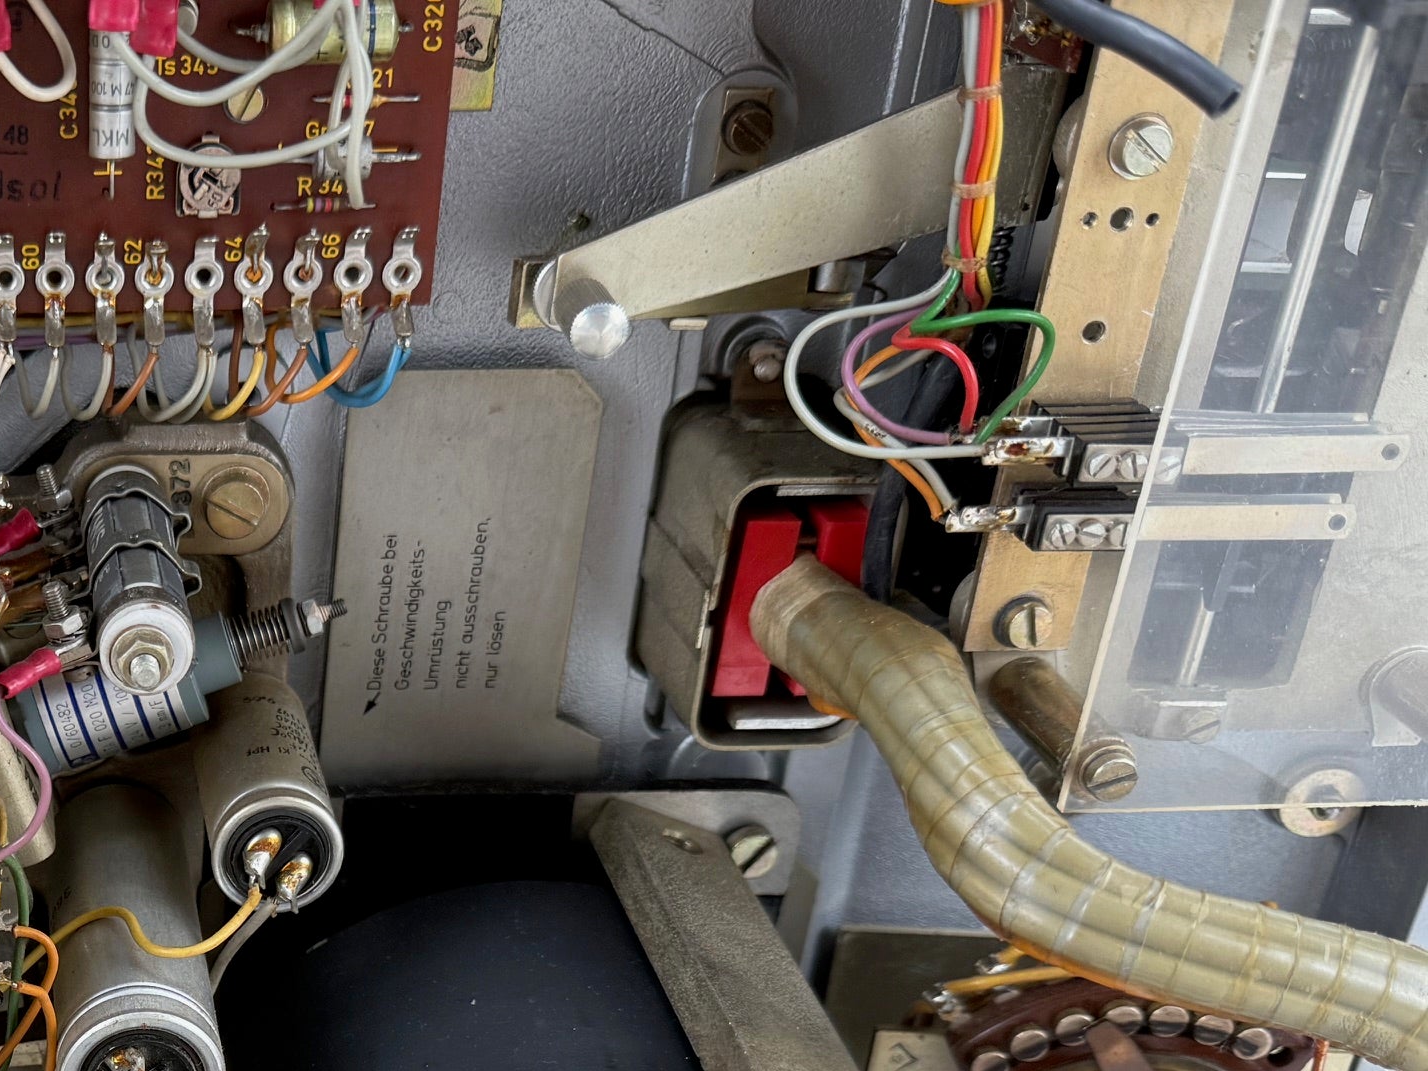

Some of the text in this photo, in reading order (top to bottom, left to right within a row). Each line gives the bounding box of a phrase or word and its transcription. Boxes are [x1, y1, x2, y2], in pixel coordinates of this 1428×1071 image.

[155, 55, 176, 76] Ts
[59, 80, 78, 139] C34
[92, 128, 130, 147] MKL
[318, 178, 350, 196] 34
[21, 243, 40, 270] 60
[123, 239, 142, 265] 62
[224, 236, 243, 262] 64
[321, 233, 341, 259] 66
[366, 533, 398, 691] Diese Schraube bei
[394, 539, 425, 691] Geschwindigkeits-
[455, 516, 492, 690] nicht ausschrauben,
[423, 599, 452, 691] Umrüstung
[484, 610, 507, 689] nur lösen
